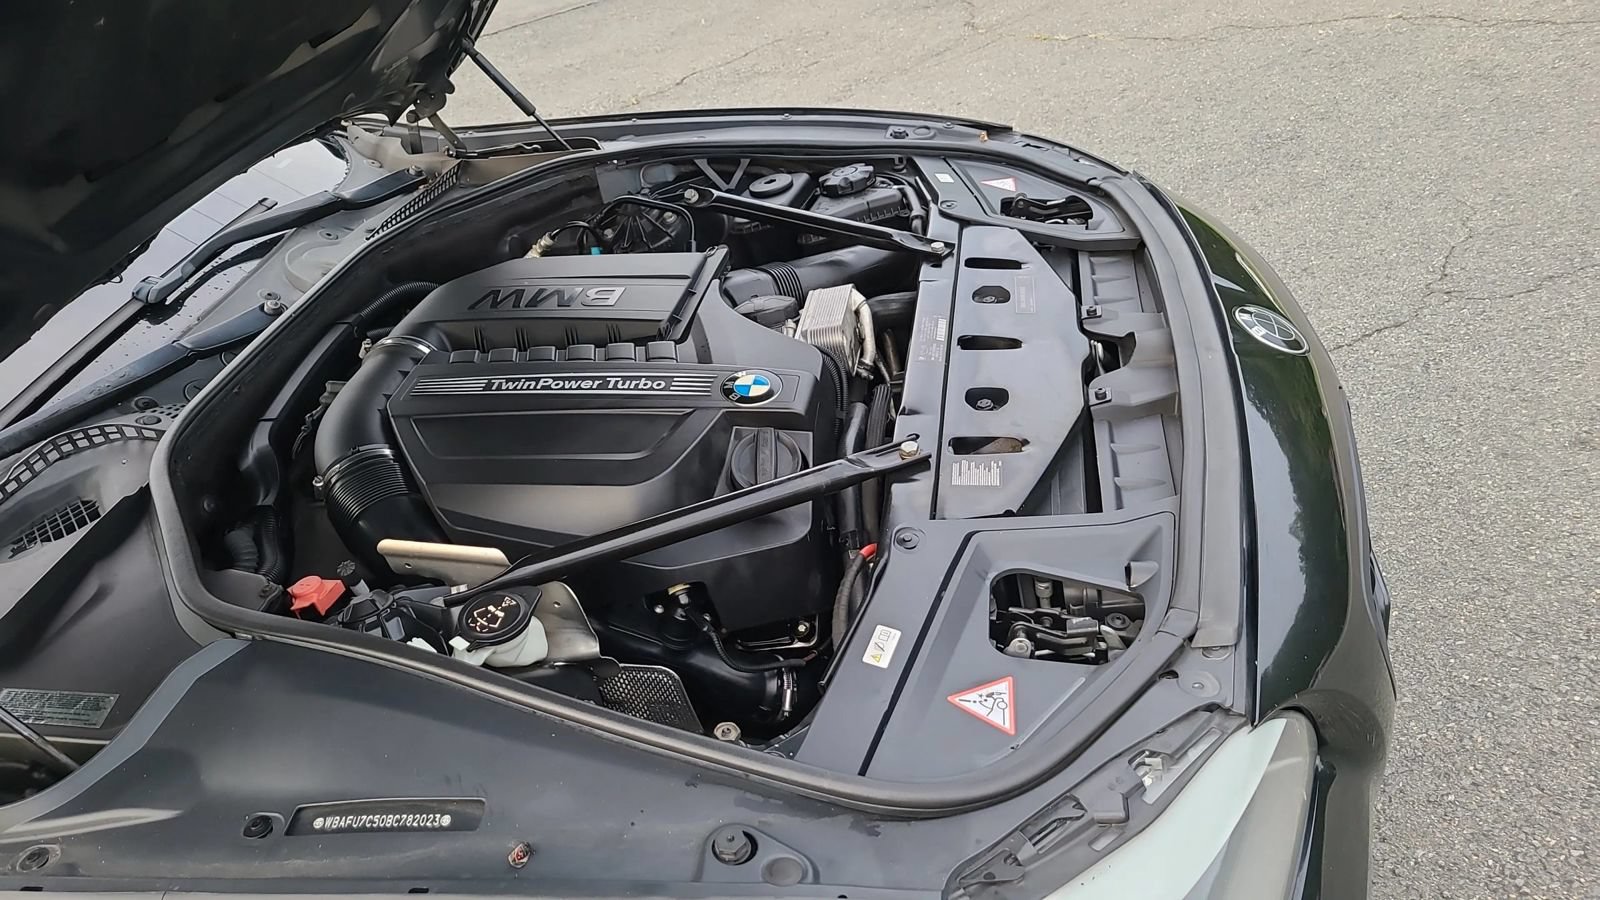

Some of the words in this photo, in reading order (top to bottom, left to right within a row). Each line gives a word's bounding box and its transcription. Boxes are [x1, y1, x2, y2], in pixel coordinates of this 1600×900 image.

[467, 287, 626, 310] BMW
[490, 377, 602, 390] TwinPower
[606, 377, 666, 390] Turbo
[324, 814, 441, 828] WBAFU7C50BC782023
